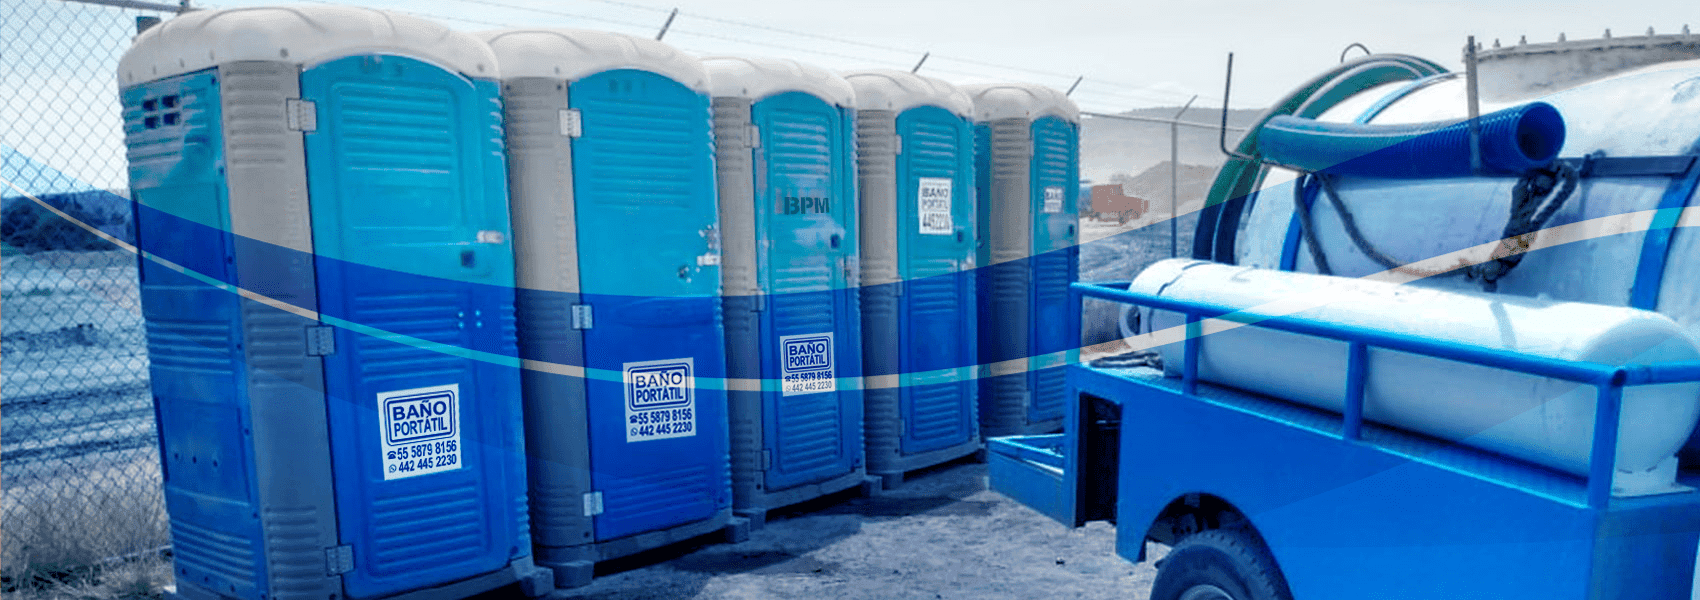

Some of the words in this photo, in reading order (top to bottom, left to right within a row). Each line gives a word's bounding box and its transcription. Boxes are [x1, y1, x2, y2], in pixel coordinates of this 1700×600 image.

[784, 196, 830, 215] BPM
[789, 341, 826, 356] BAÑO
[635, 370, 683, 389] BAÑO
[791, 373, 800, 383] 55
[800, 371, 816, 382] 5879
[816, 370, 833, 380] 8156
[792, 383, 804, 392] 442
[804, 381, 816, 391] 445
[817, 380, 833, 390] 2230
[392, 399, 447, 421] BAÑO
[638, 412, 649, 425] 55
[650, 410, 671, 424] 5879
[672, 408, 693, 421] 8156
[393, 415, 448, 437] PORTÁTIL
[639, 425, 655, 437] 442
[656, 422, 671, 435] 445
[672, 421, 693, 434] 2230
[397, 446, 409, 461] 55
[410, 442, 433, 459] 5879
[435, 439, 457, 455] 8156
[398, 459, 415, 473] 442
[417, 456, 434, 470] 445
[435, 453, 457, 468] 2230
